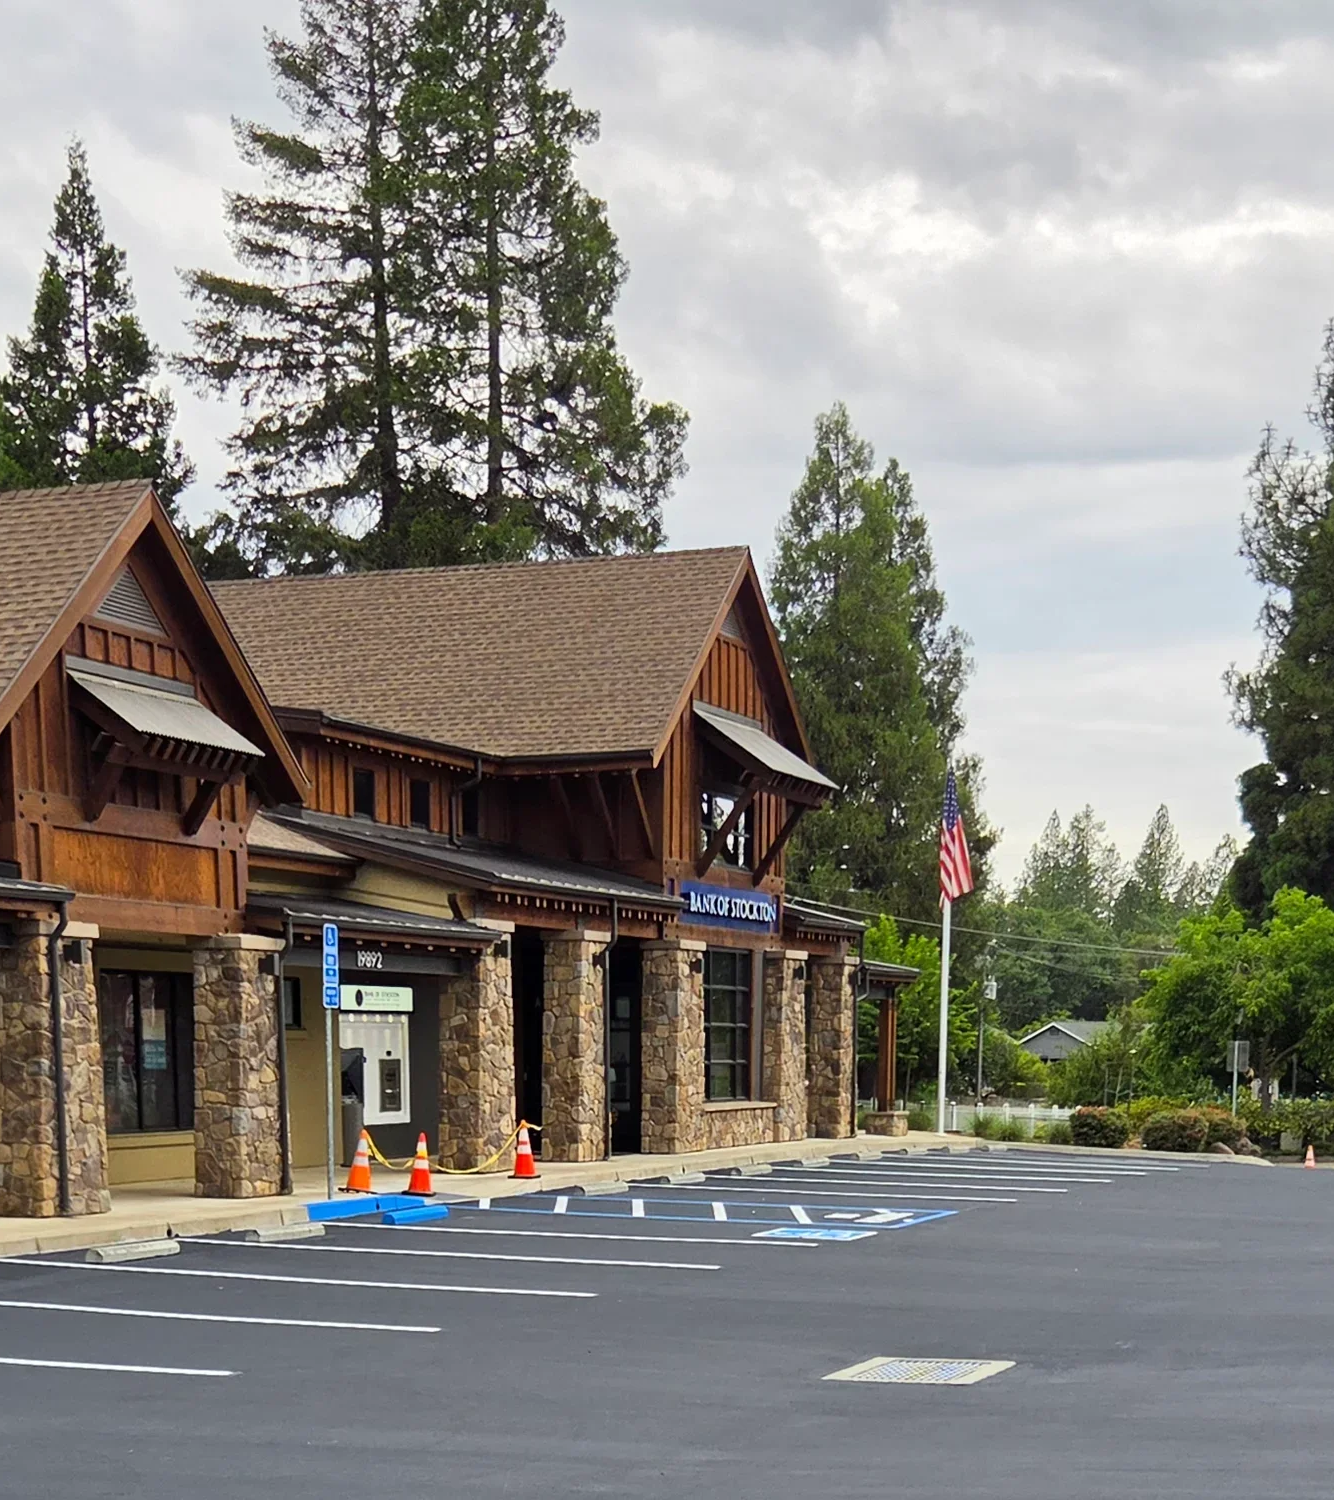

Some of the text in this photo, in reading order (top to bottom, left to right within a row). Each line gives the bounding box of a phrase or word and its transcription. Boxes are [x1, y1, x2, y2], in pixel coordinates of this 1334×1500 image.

[690, 891, 776, 922] BANK OF STOCKTON
[357, 950, 383, 968] 19892
